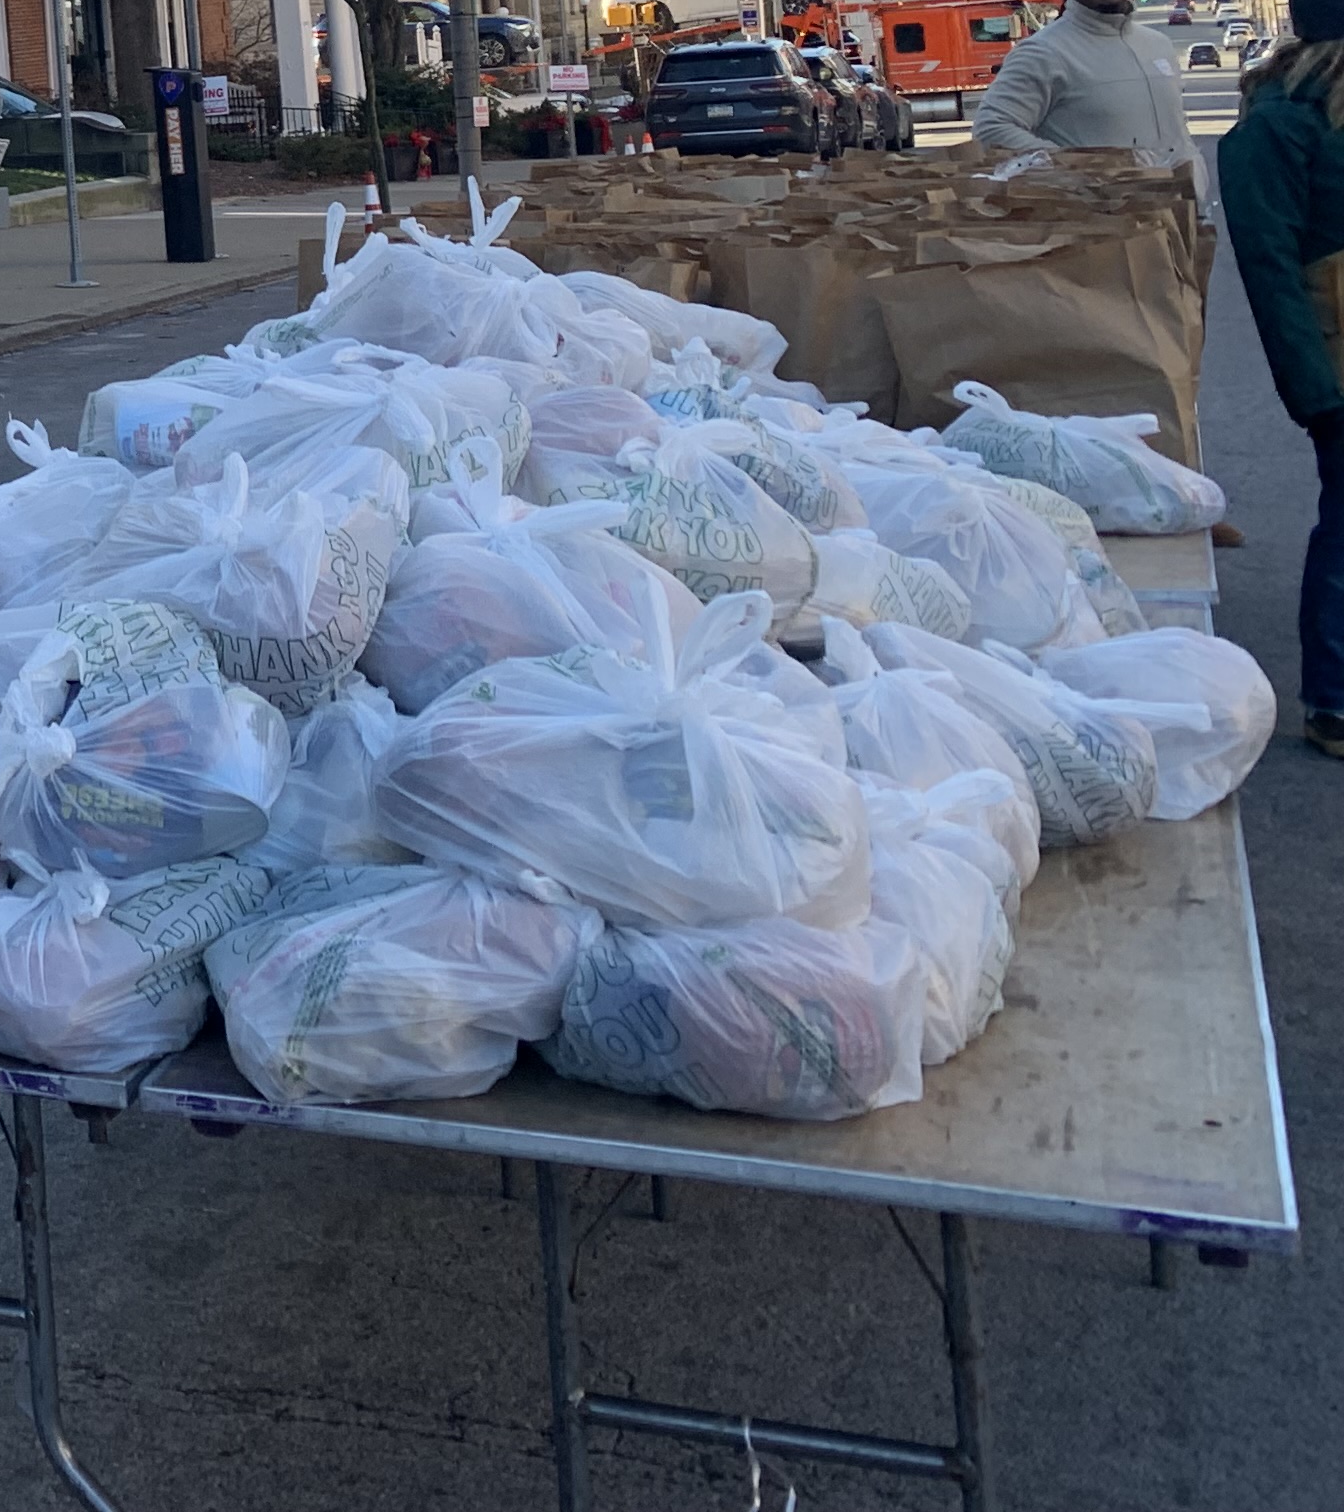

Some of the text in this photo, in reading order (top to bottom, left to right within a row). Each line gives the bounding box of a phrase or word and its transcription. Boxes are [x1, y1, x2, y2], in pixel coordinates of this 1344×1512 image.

[562, 66, 574, 74] NO
[552, 72, 586, 80] PARKING
[675, 516, 764, 565] YOU
